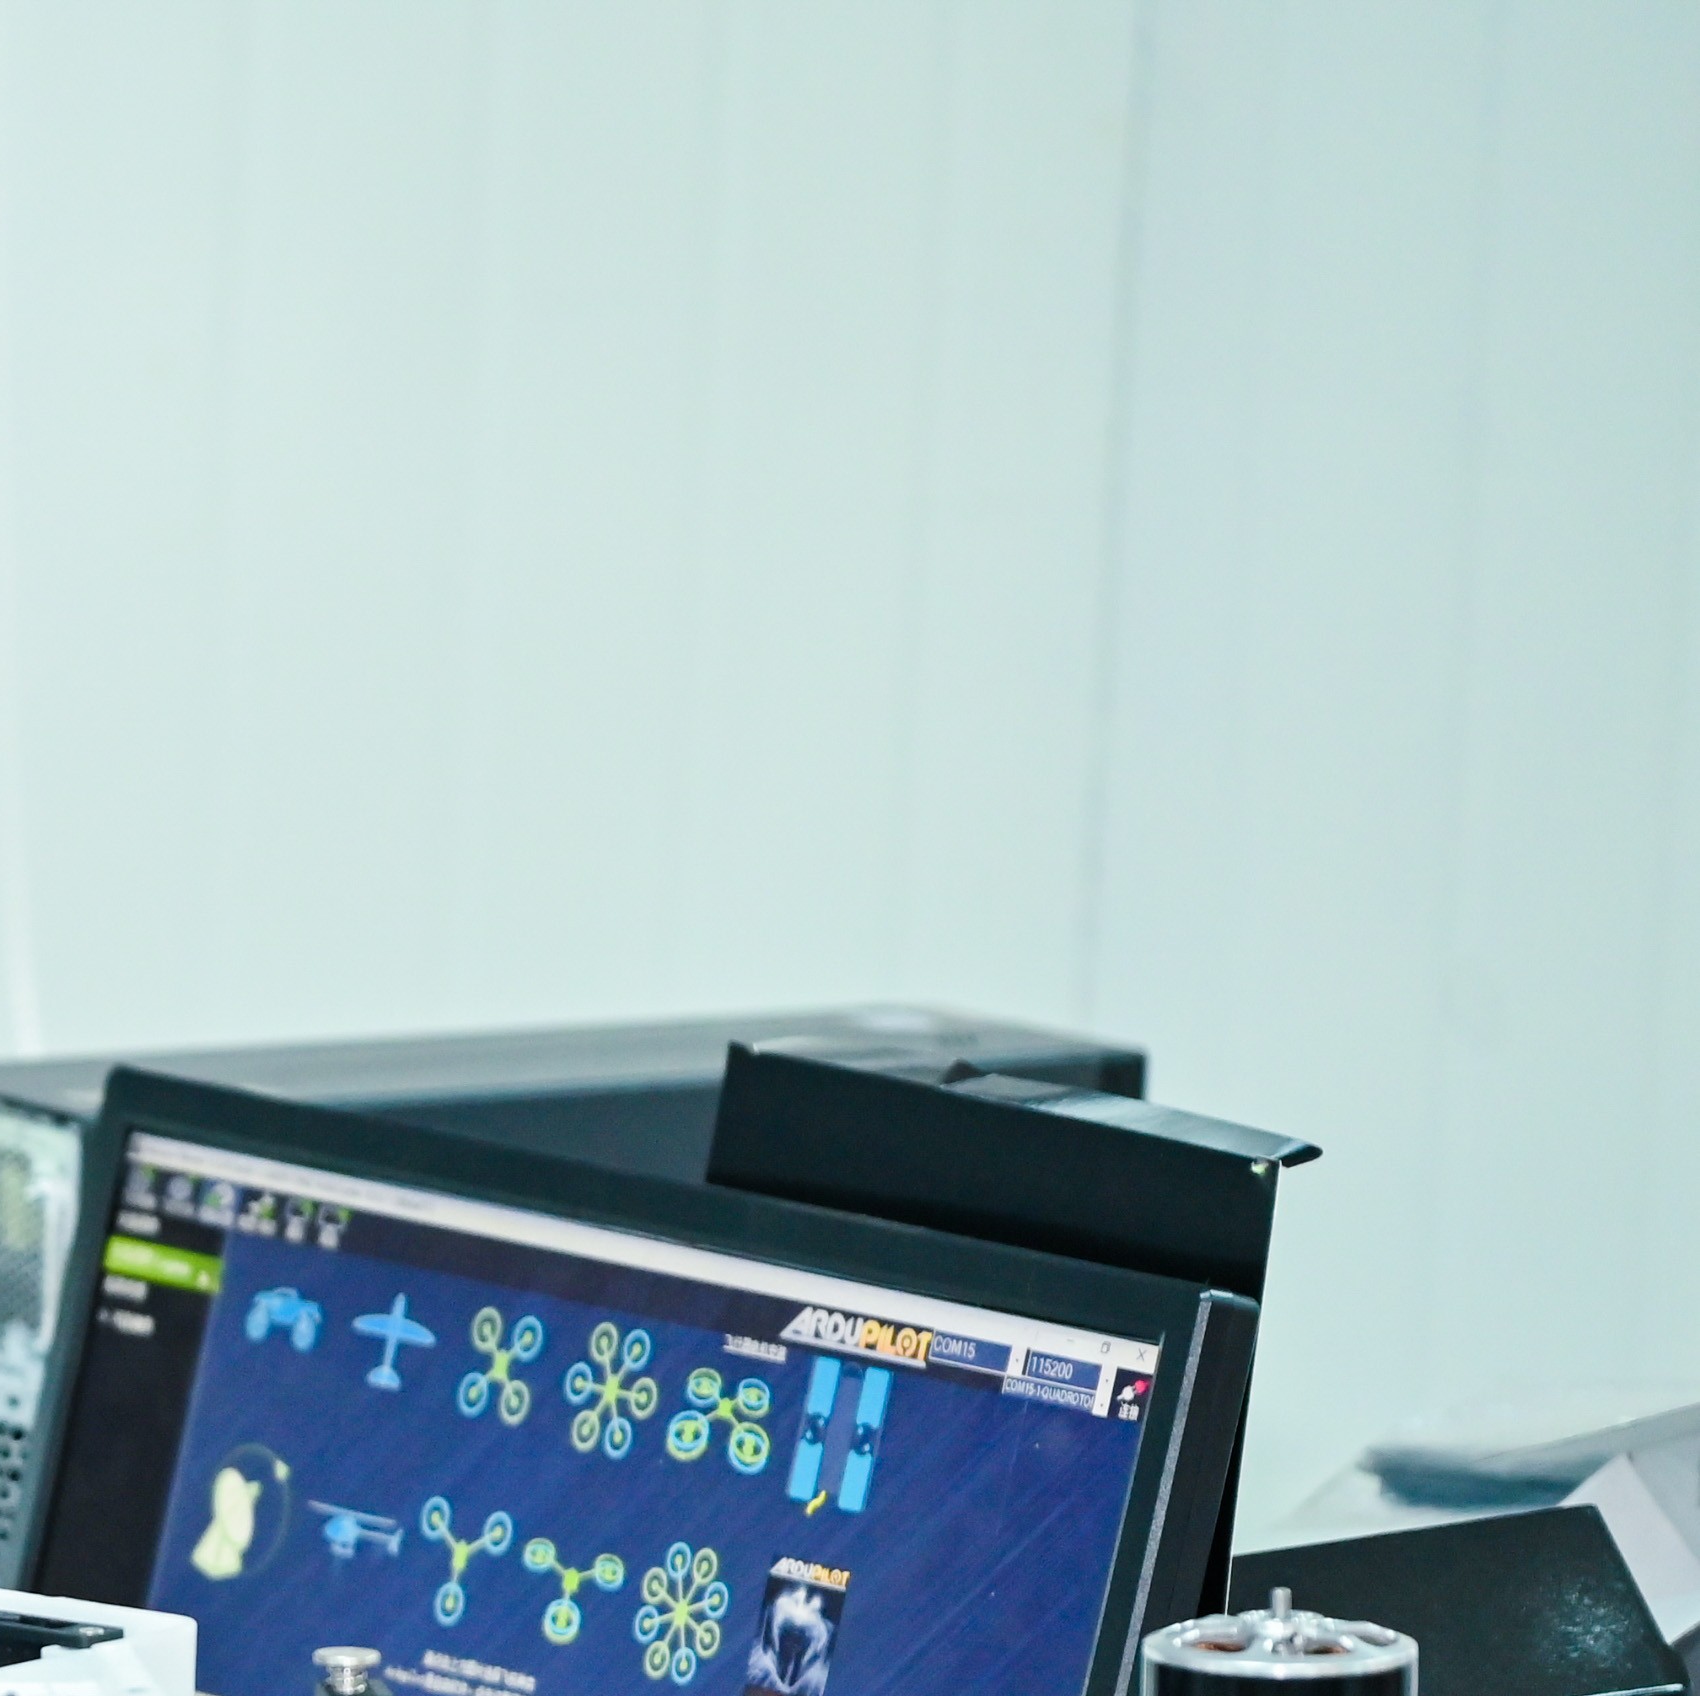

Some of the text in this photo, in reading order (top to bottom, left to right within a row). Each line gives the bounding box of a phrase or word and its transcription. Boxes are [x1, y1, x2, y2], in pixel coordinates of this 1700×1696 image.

[780, 1307, 932, 1368] ARDUPILOT
[933, 1332, 976, 1359] COM15
[1032, 1356, 1073, 1380] 115200
[770, 1557, 850, 1591] ARDUPILOT
